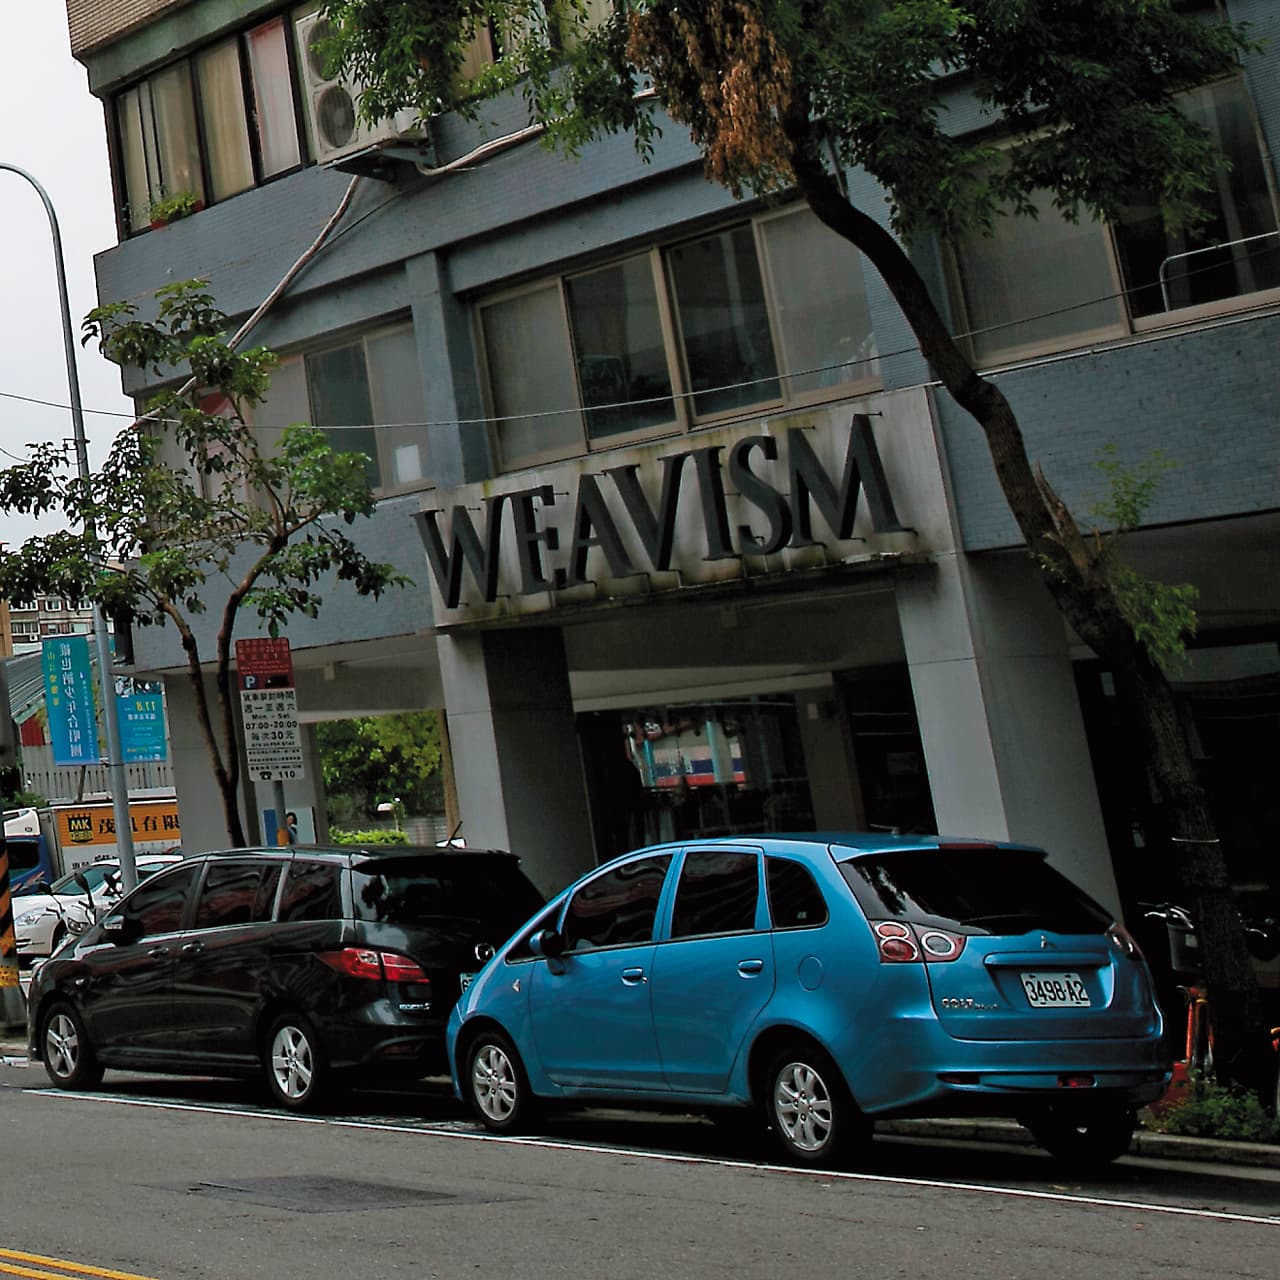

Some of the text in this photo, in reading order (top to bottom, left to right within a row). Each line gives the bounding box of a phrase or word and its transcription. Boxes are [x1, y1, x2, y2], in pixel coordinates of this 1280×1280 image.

[410, 413, 918, 610] WEAVISM
[245, 675, 256, 688] P
[71, 819, 90, 830] MK
